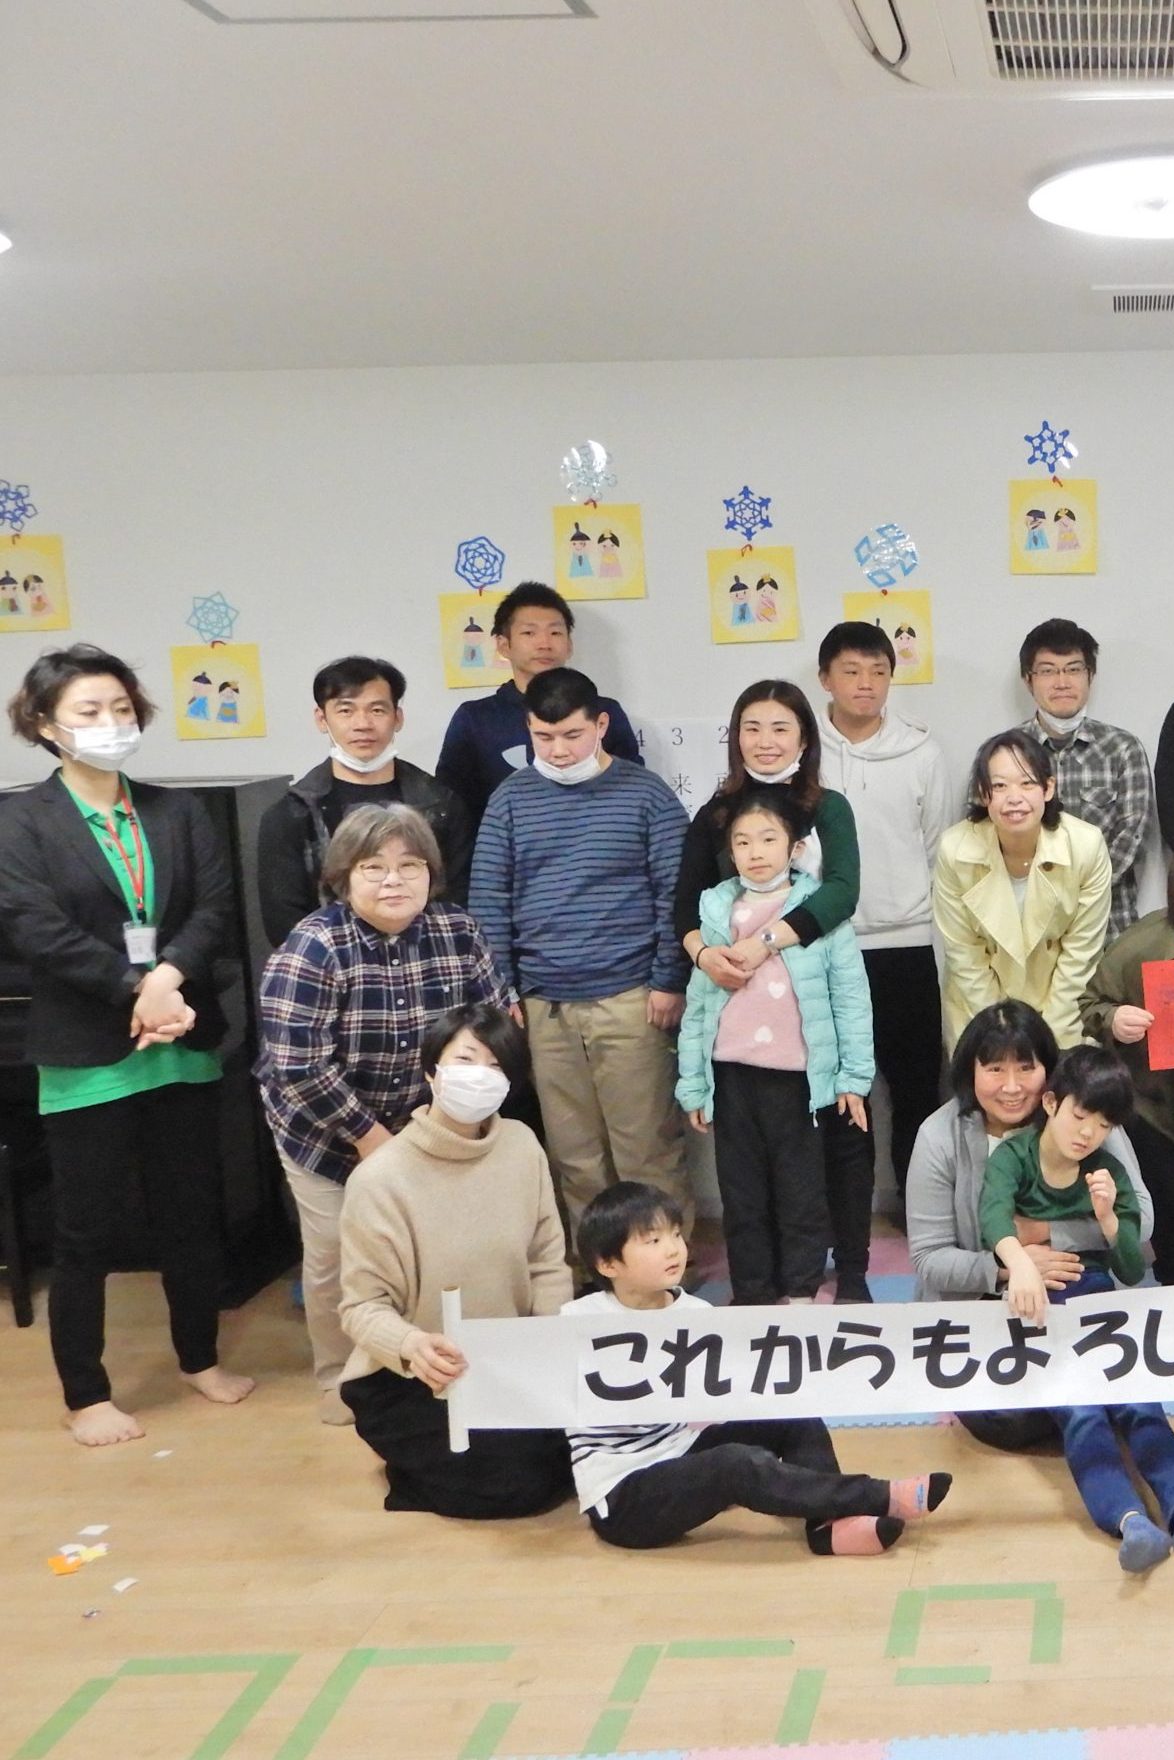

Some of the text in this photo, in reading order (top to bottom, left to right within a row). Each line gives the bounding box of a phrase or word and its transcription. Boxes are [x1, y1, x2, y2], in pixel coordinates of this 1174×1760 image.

[635, 725, 729, 748] 4 3 2
